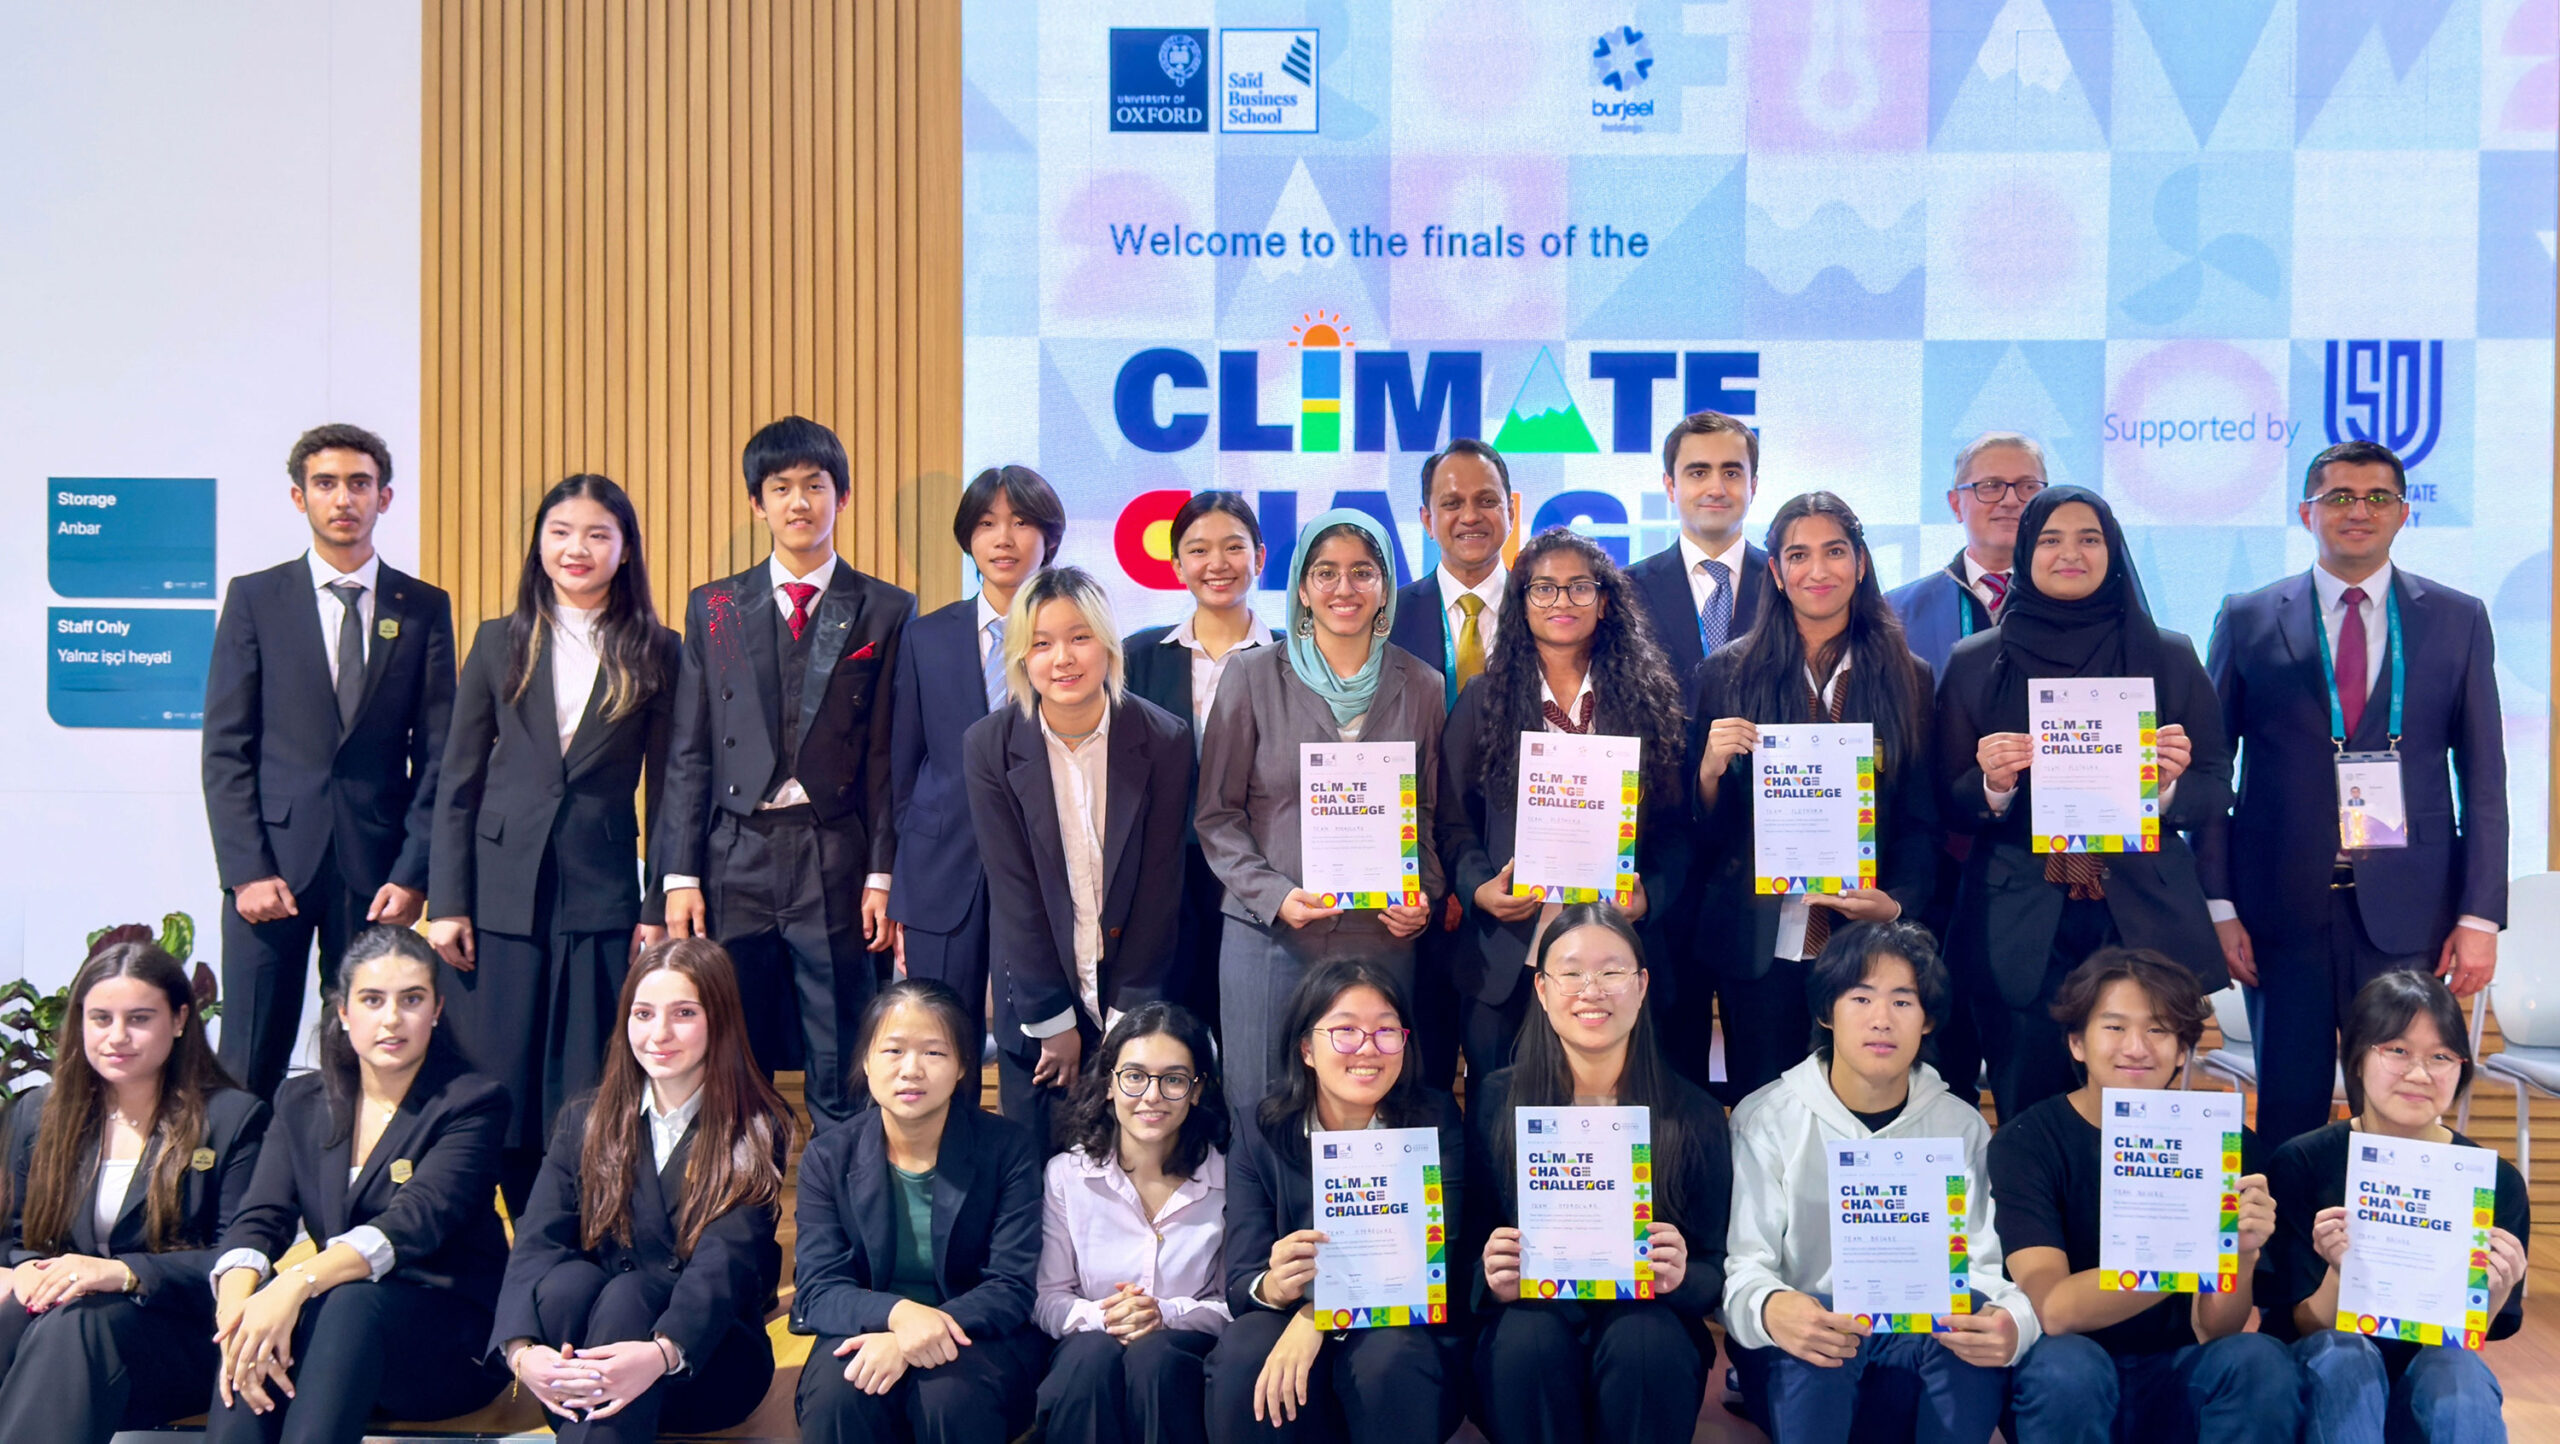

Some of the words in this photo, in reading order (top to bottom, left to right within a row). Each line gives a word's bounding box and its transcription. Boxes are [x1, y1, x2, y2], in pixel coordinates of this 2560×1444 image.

[1228, 72, 1263, 89] Saïd
[1117, 95, 1170, 104] UNIVERSITY
[1173, 95, 1185, 104] OF
[1228, 91, 1298, 105] Business
[1116, 107, 1202, 124] OXFORD
[1228, 108, 1282, 124] School
[1592, 99, 1654, 121] burjeel
[1109, 223, 1287, 257] Welcome
[1300, 227, 1335, 257] to
[1350, 223, 1407, 257] the
[1423, 223, 1525, 257] finals
[1541, 223, 1577, 257] of
[1590, 223, 1649, 257] the
[1113, 336, 1759, 454] CLIMATE
[2104, 412, 2256, 448] Supported
[2267, 412, 2301, 448] by
[58, 491, 117, 508] Storage
[2406, 484, 2437, 502] TATE
[58, 521, 102, 535] Anbar
[58, 619, 95, 634] Staff
[96, 620, 130, 636] Only
[58, 649, 99, 664] Yalnız
[101, 650, 126, 666] işçi
[128, 650, 172, 666] heyəti
[2041, 719, 2102, 730] CLIMATE
[2041, 732, 2100, 742] CHANGE
[2042, 744, 2123, 755] CHALLENGE
[1763, 764, 1823, 775] CLIMATE
[1530, 772, 1588, 785] CLIMATE
[1764, 777, 1820, 786] CHANGE
[1310, 781, 1367, 792] CLIMATE
[1529, 784, 1584, 797] CHANGE
[1764, 788, 1842, 799] CHALLENGE
[1310, 794, 1365, 804] CHANGE
[1528, 796, 1605, 810] CHALLENGE
[1310, 805, 1385, 816] CHALLENGE
[2114, 1136, 2182, 1150] CLIMATE
[1529, 1151, 1594, 1164] CLIMATE
[2114, 1151, 2179, 1165] CHANGE
[1529, 1166, 1591, 1177] CHANGE
[2114, 1165, 2204, 1180] CHALLENGE
[1324, 1176, 1388, 1190] CLIMATE
[1529, 1180, 1615, 1191] CHALLENGE
[1840, 1183, 1907, 1197] CLIMATE
[1325, 1190, 1385, 1204] CHANGE
[2359, 1181, 2431, 1201] CLIMATE
[1325, 1203, 1409, 1218] CHALLENGE
[1841, 1199, 1905, 1210] CHANGE
[2358, 1195, 2427, 1214] CHANGE
[1842, 1212, 1930, 1224] CHALLENGE
[2357, 1209, 2452, 1232] CHALLENGE
